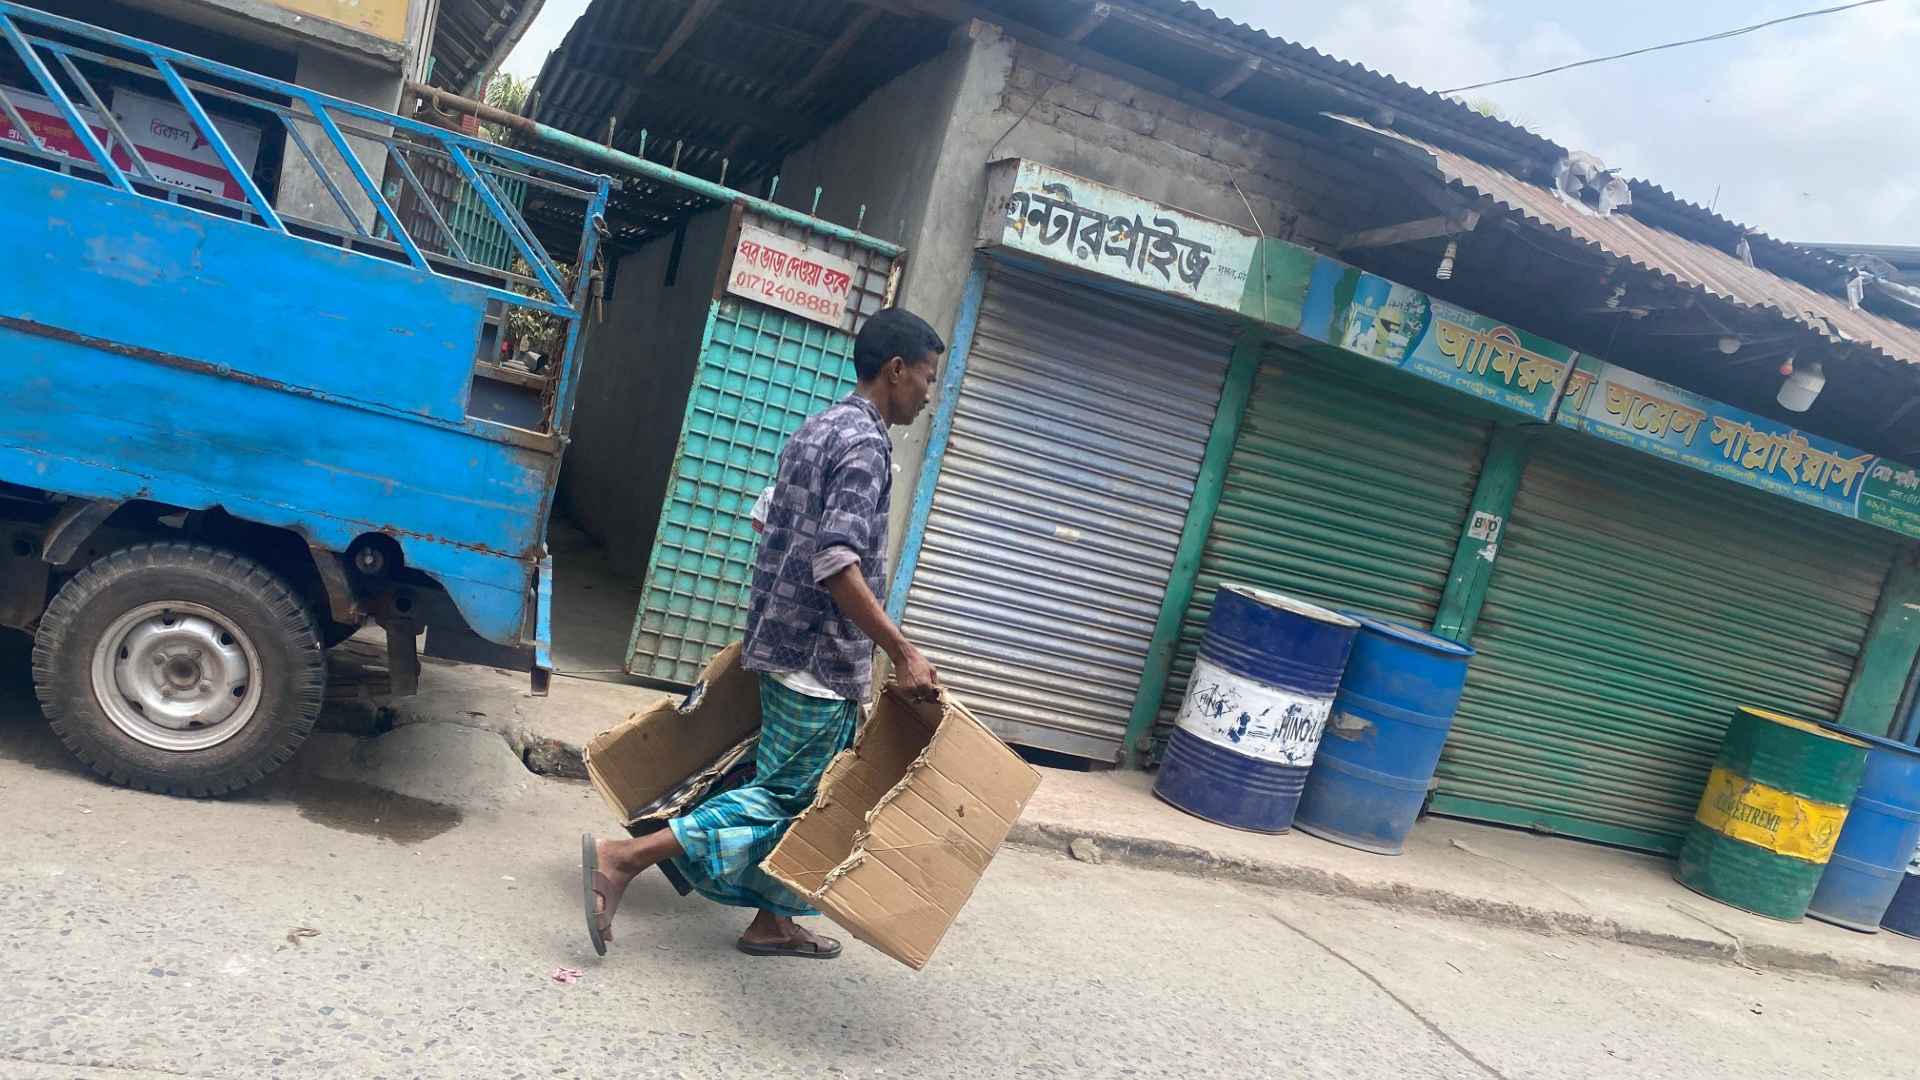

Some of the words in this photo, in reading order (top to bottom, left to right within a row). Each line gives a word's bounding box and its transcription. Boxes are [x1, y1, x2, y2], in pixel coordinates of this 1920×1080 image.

[740, 241, 761, 265] ঘর
[760, 246, 786, 280] ভাড়া
[786, 255, 824, 288] দেওয়া
[823, 266, 851, 297] হবে
